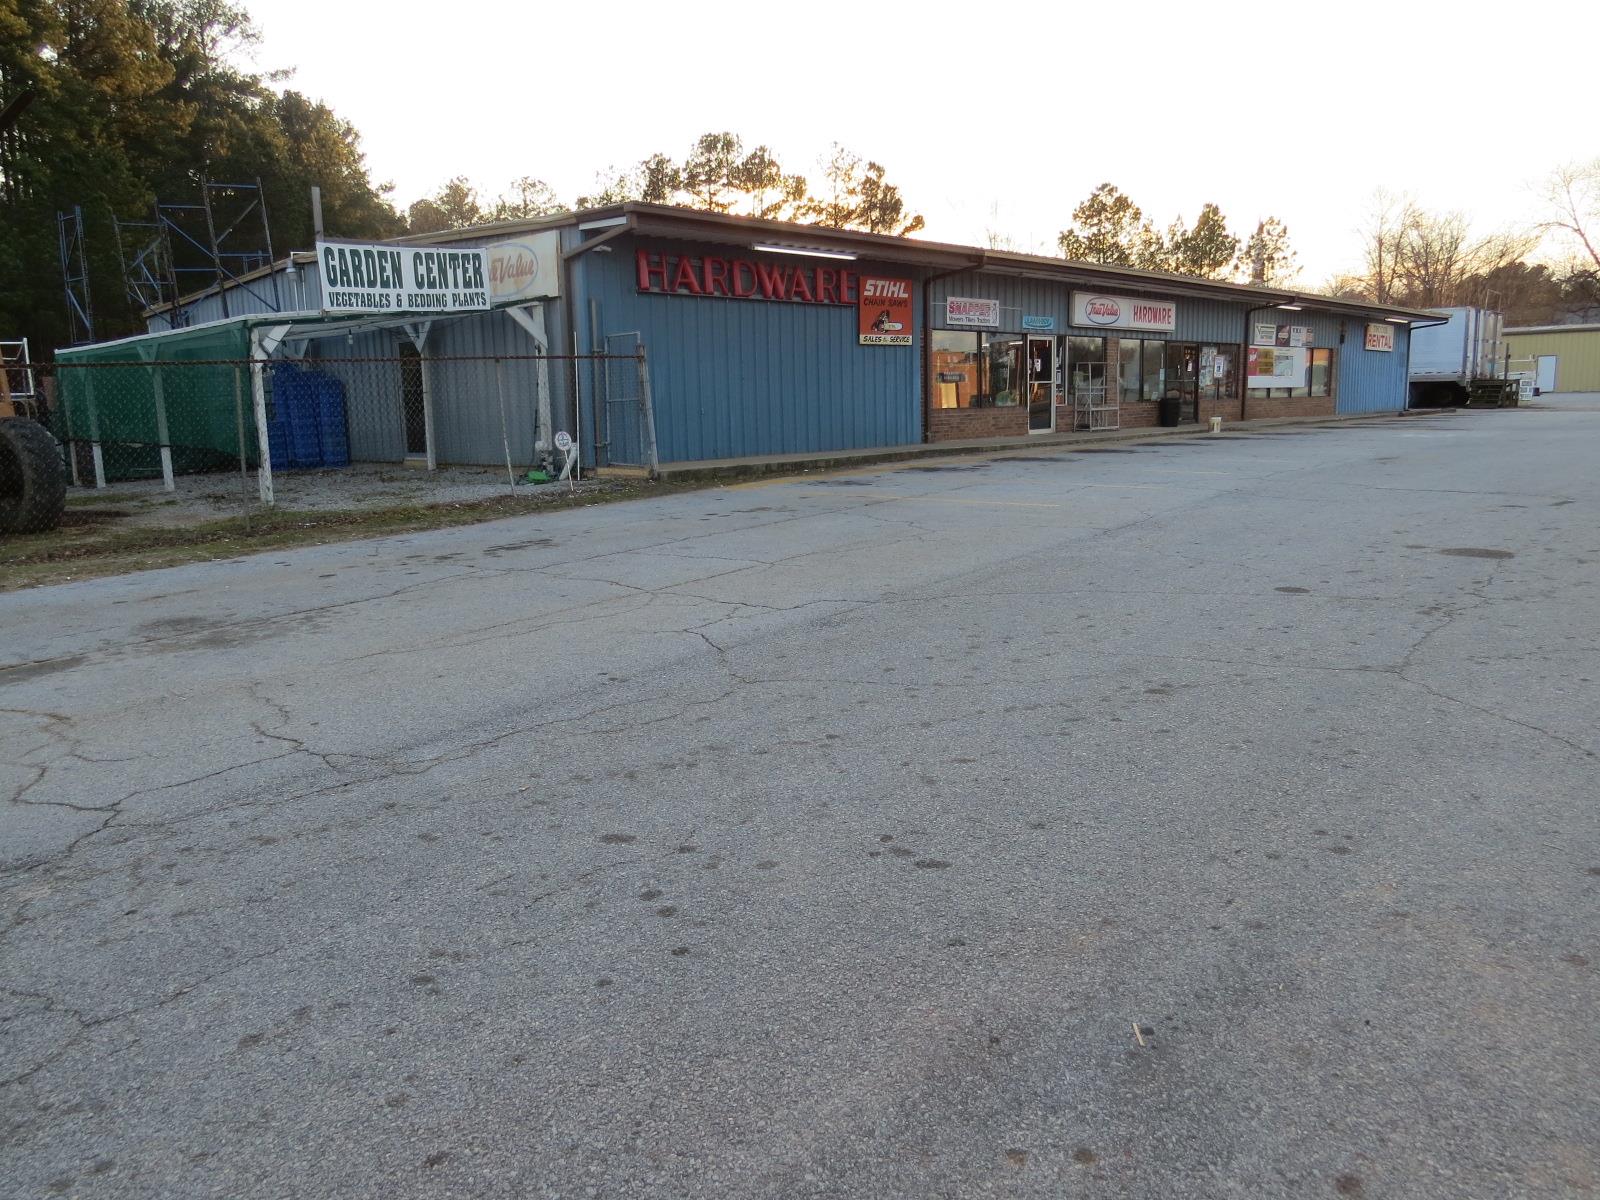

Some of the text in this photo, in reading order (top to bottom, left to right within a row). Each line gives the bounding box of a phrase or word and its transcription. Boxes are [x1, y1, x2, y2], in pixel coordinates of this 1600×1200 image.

[323, 246, 404, 290] GARDEN
[413, 251, 485, 290] CENTER
[496, 253, 534, 283] Value
[636, 249, 857, 304] HARDWARE
[863, 279, 909, 298] STIHL
[328, 291, 487, 309] VEGETABLES & BEDDING PLANTS
[863, 297, 908, 308] CHAIN SAWS
[1088, 302, 1119, 317] True Value
[1133, 305, 1171, 325] HARDWARE
[863, 335, 882, 343] SALES
[1365, 333, 1392, 349] RENTAL
